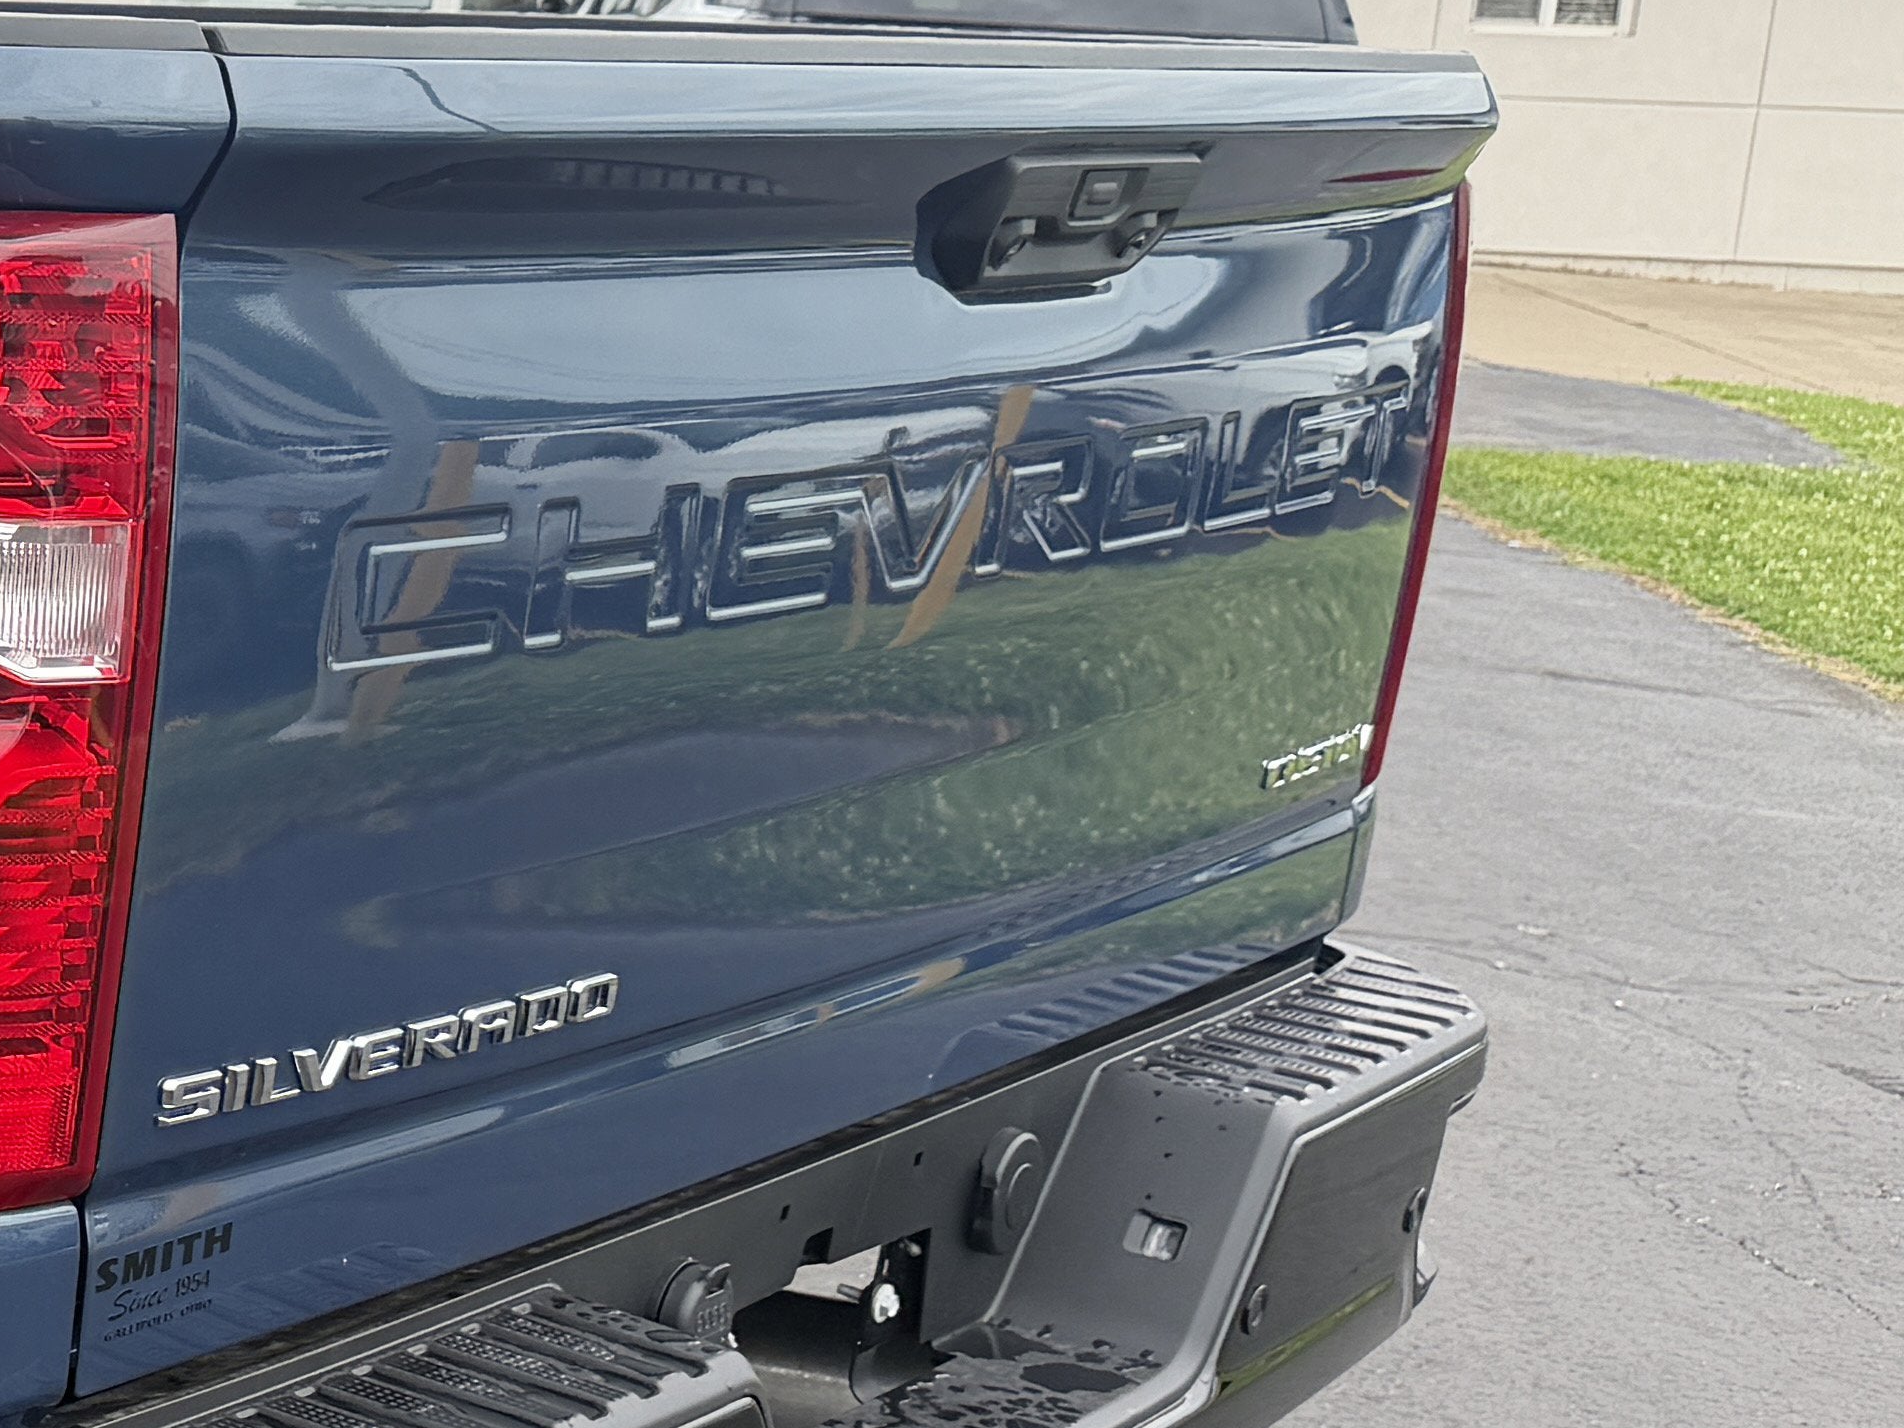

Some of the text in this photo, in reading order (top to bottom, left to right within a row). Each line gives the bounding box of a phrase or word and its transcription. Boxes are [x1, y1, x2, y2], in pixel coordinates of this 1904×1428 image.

[325, 378, 1410, 673] CHEVROLET
[153, 972, 619, 1128] SILVERADO
[95, 1222, 233, 1293] SMITH
[108, 1269, 210, 1321] Since 1954
